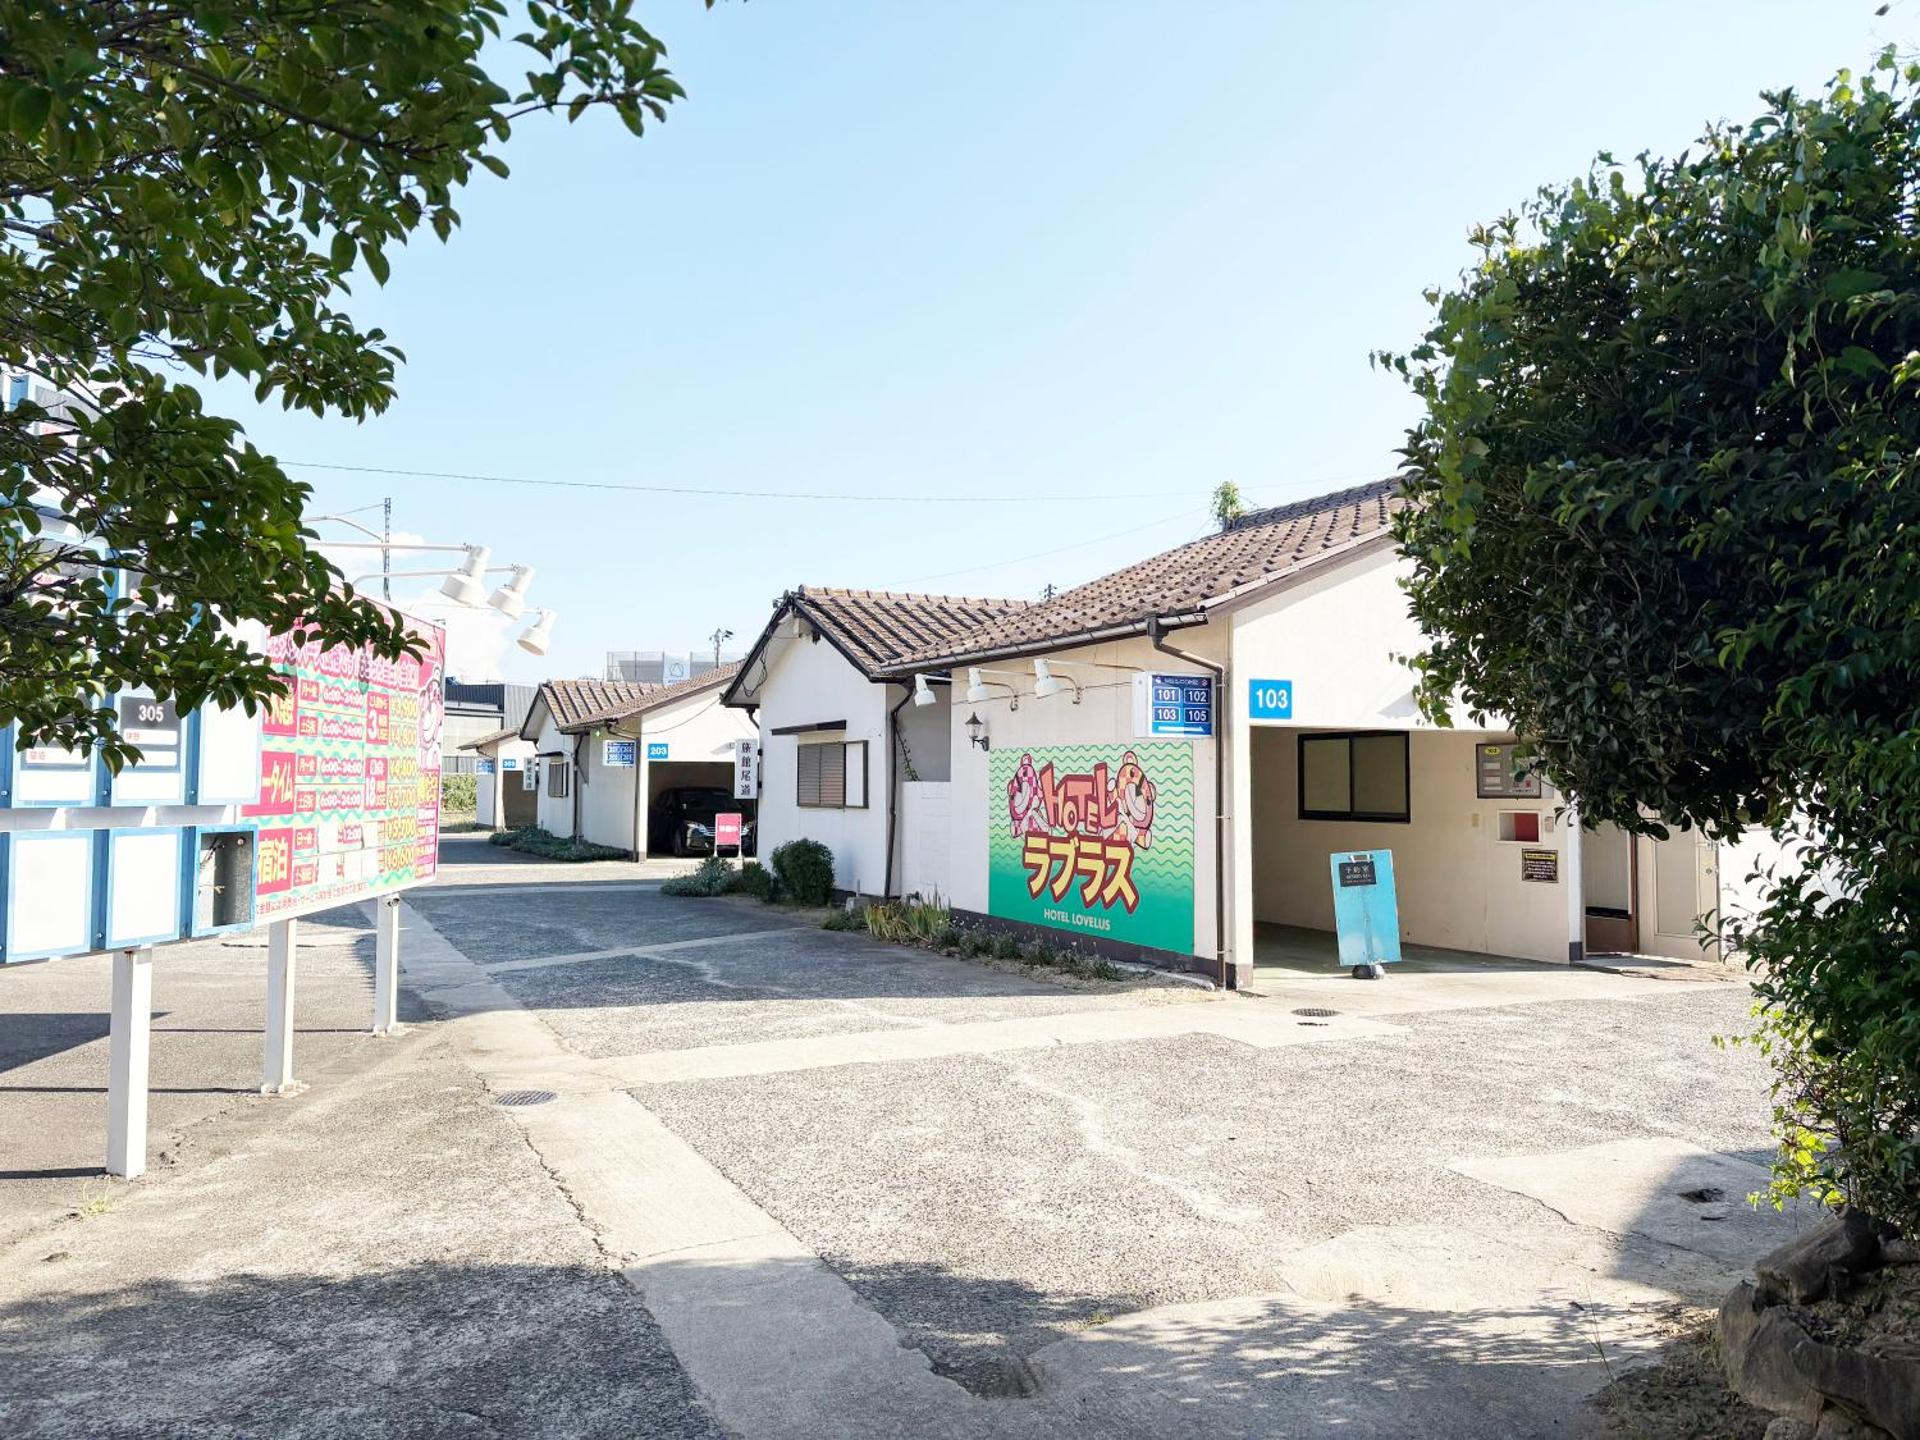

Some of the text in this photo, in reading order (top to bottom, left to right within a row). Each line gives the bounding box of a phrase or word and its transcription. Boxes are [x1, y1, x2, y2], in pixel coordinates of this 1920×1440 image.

[1158, 689, 1207, 702] 101 102
[1256, 688, 1288, 709] 103
[138, 705, 164, 722] 305
[1158, 708, 1207, 722] 103 105
[1040, 763, 1118, 834] HOTEL
[258, 838, 288, 884] 宿泊
[1023, 832, 1138, 913] ラブラス
[1044, 908, 1111, 931] HOTEL LOVELUS
